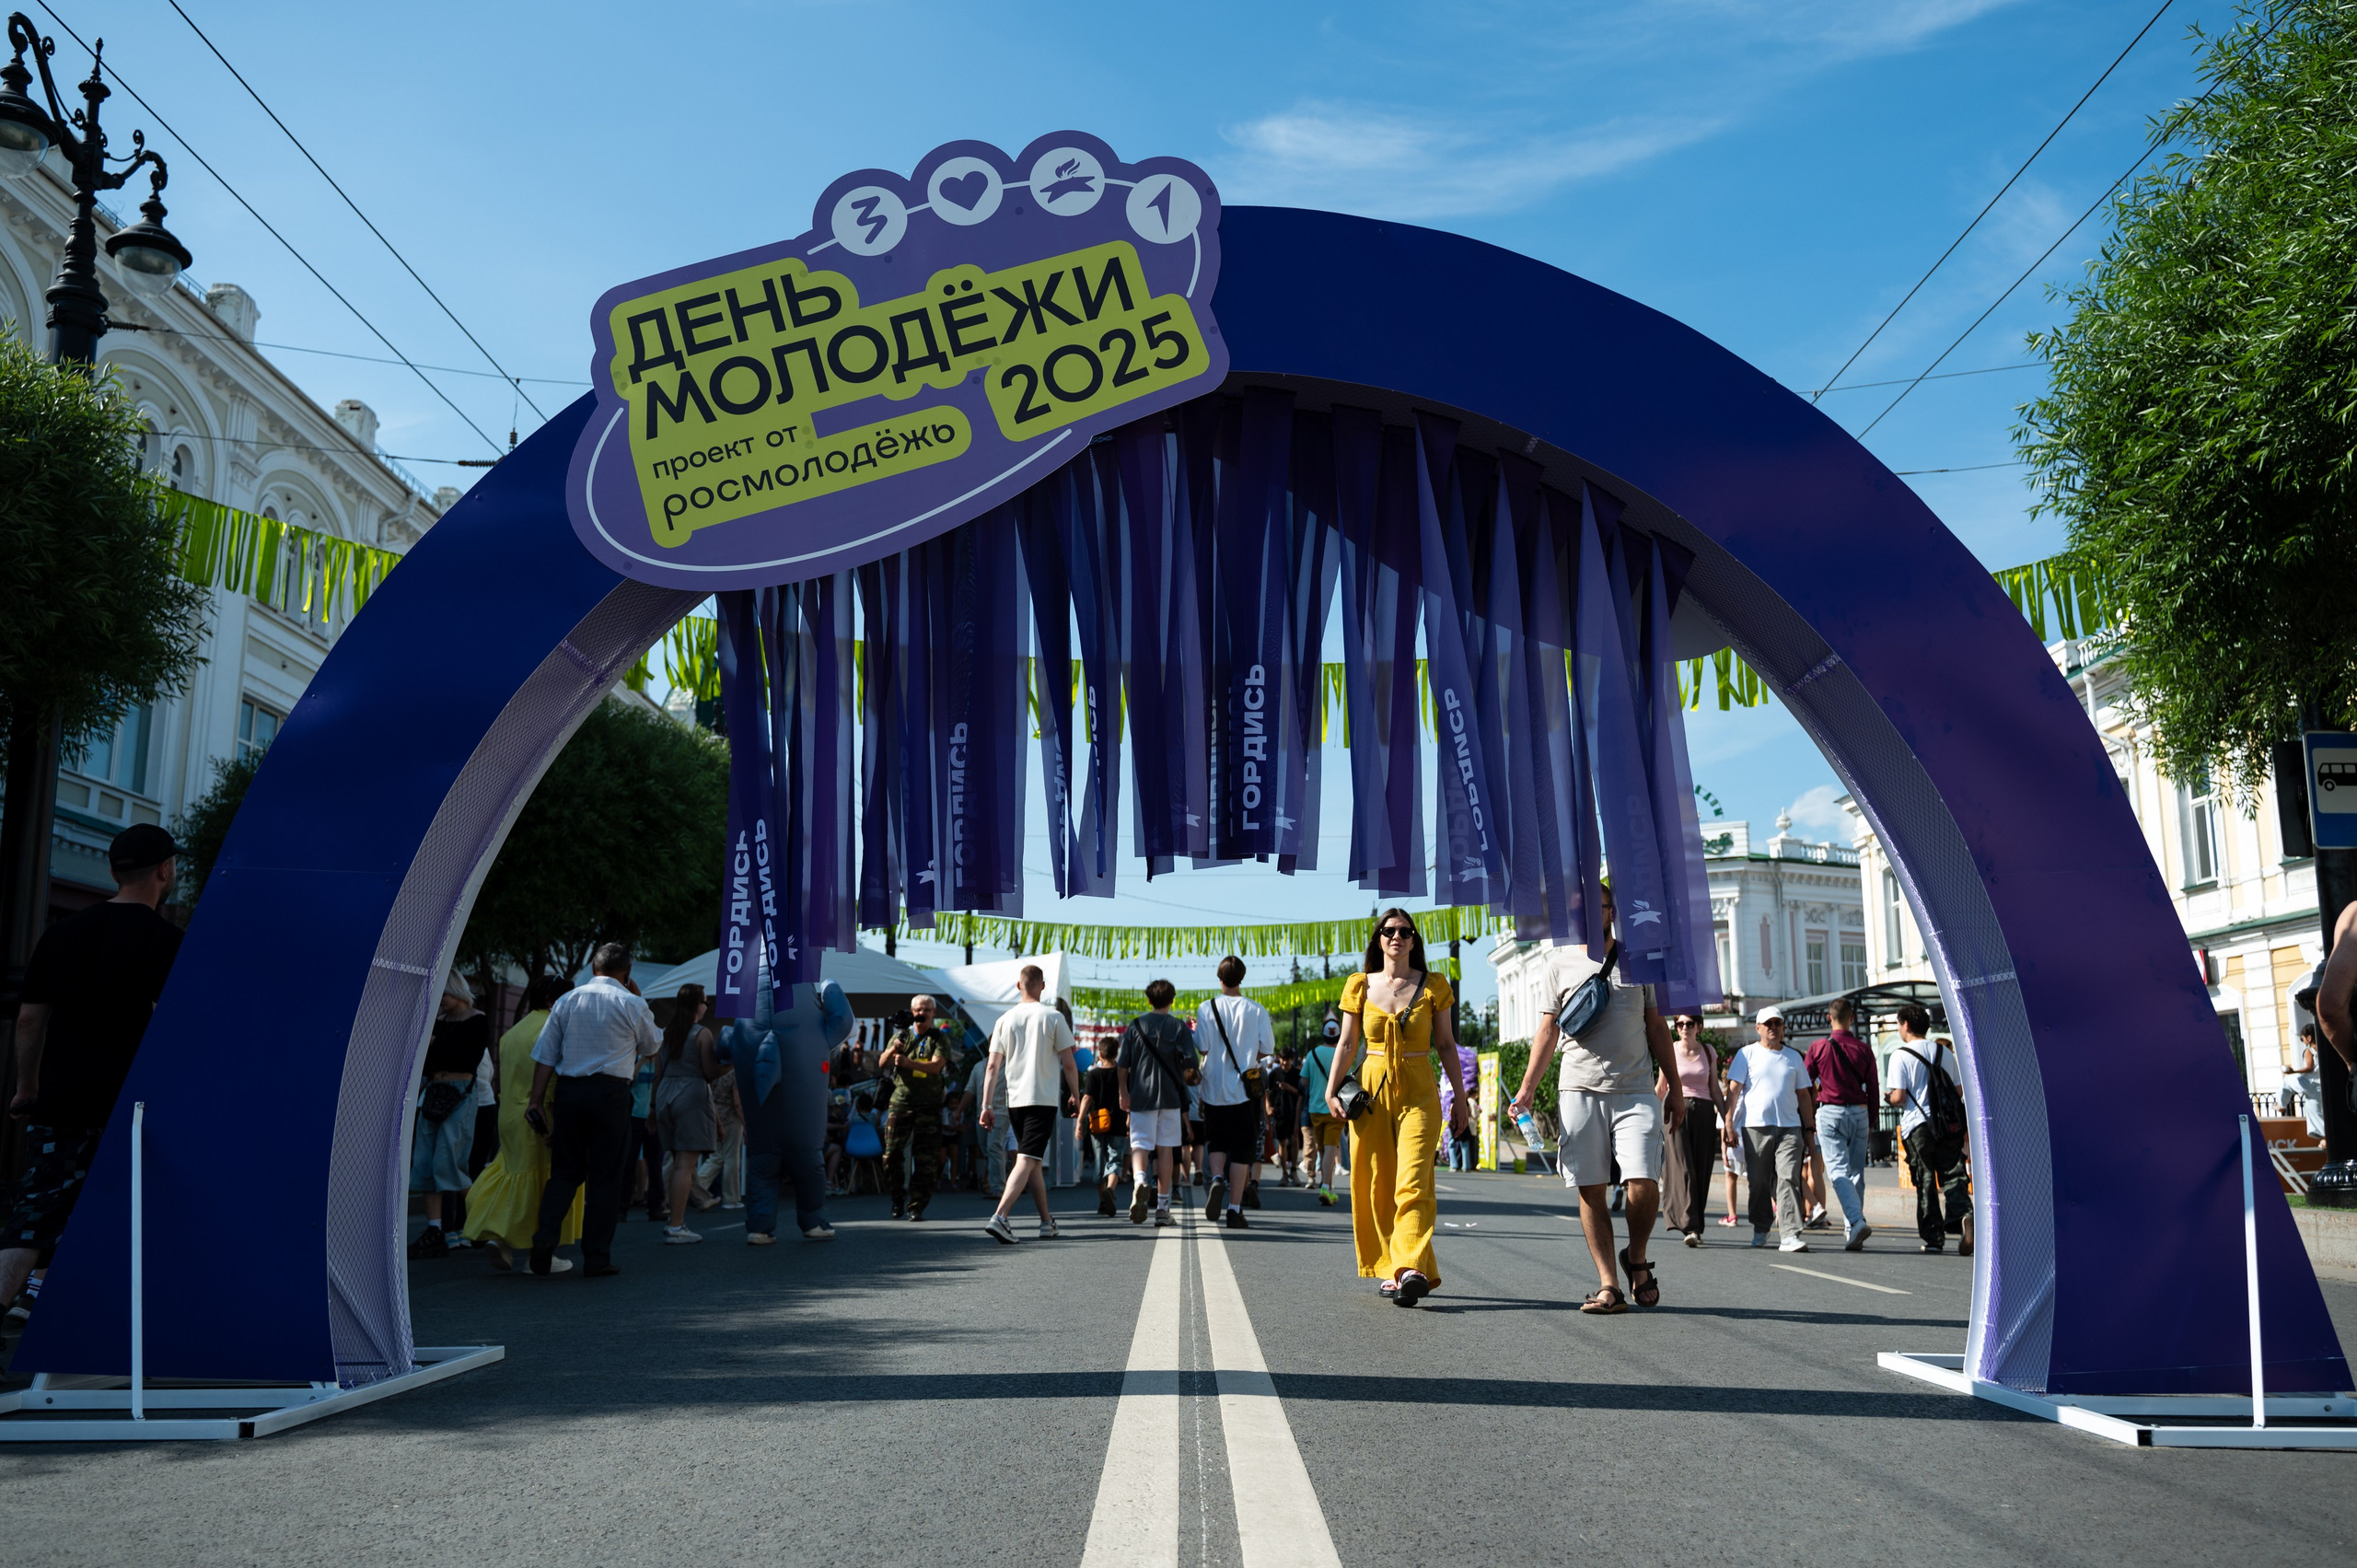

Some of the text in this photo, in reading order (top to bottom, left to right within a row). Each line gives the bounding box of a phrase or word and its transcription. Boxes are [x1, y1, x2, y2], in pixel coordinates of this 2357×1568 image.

[627, 273, 842, 385] ДЕНЬ
[646, 256, 1134, 440] МОЛОДЁЖИ
[1001, 310, 1190, 424] 2025
[652, 425, 798, 481] проект от
[663, 424, 956, 531] росмолодёжь
[1242, 664, 1268, 830] ГОРДИСЬ
[725, 829, 751, 994] ГОРДИСЬ
[754, 818, 781, 990] ГОРДИСЬ
